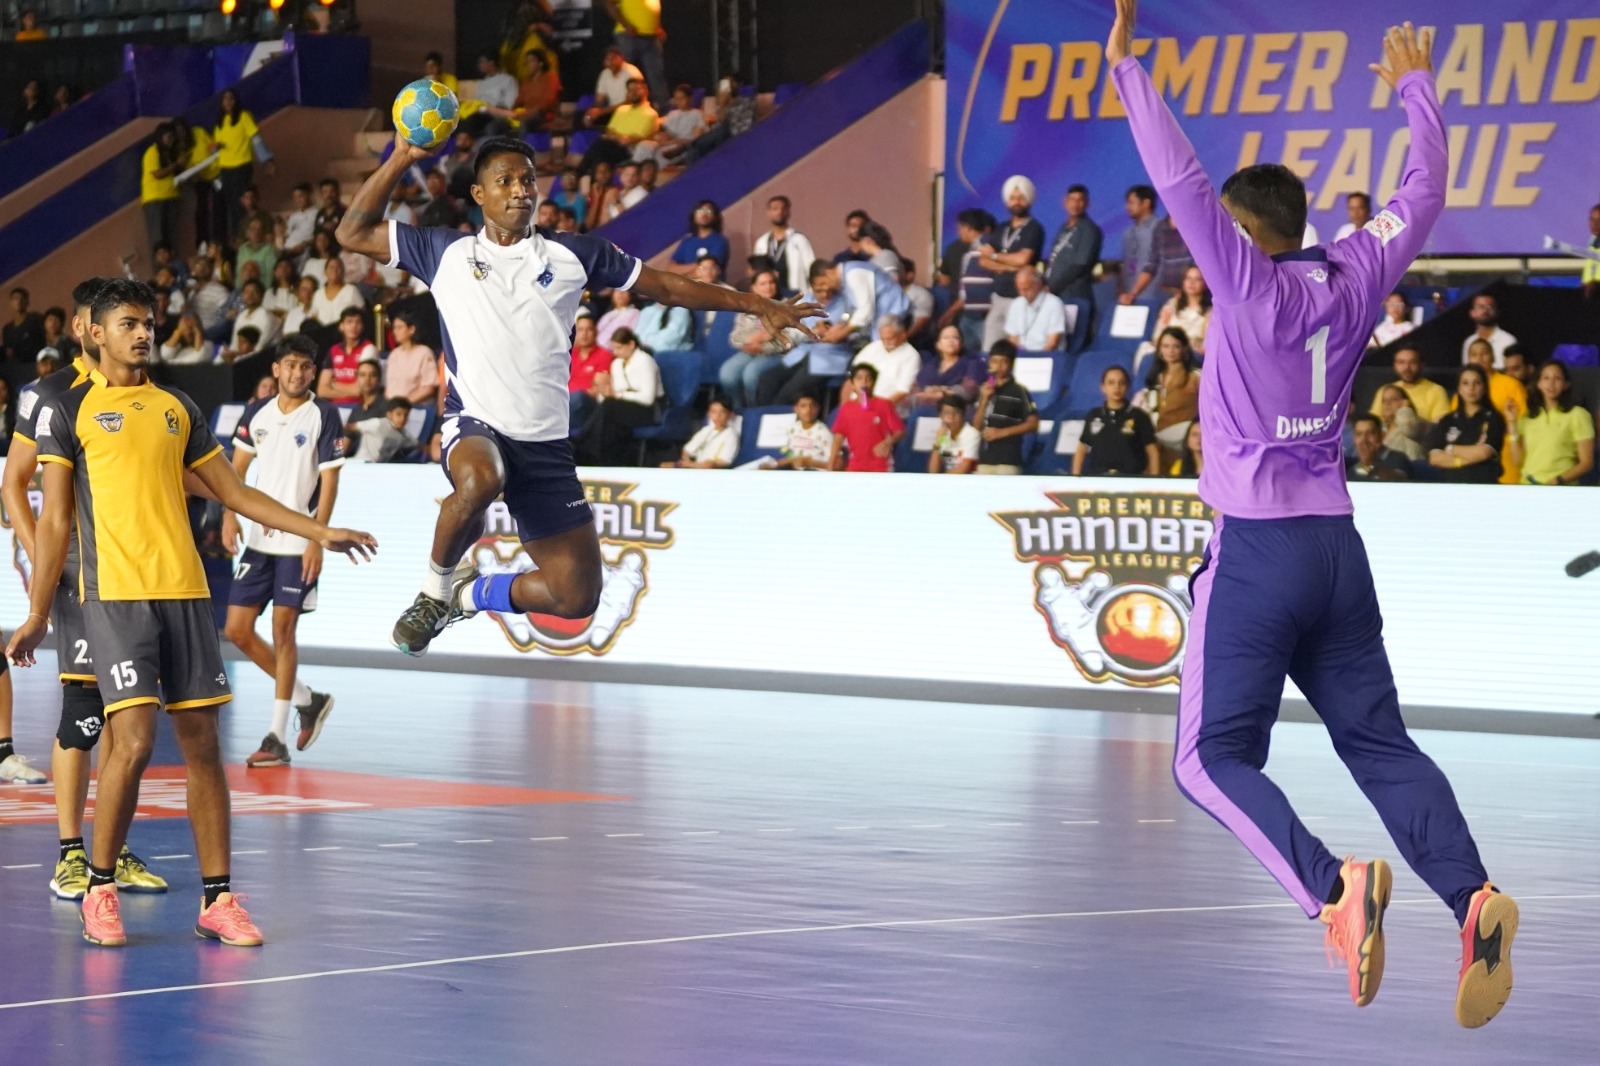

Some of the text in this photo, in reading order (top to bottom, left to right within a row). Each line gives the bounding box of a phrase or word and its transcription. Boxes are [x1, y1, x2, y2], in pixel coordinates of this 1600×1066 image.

[999, 31, 1349, 122] PREMIER
[1305, 325, 1330, 404] 1
[1078, 498, 1204, 517] PREMIER
[1101, 553, 1180, 568] LEAGUE
[74, 639, 93, 664] 2
[110, 660, 138, 691] 15
